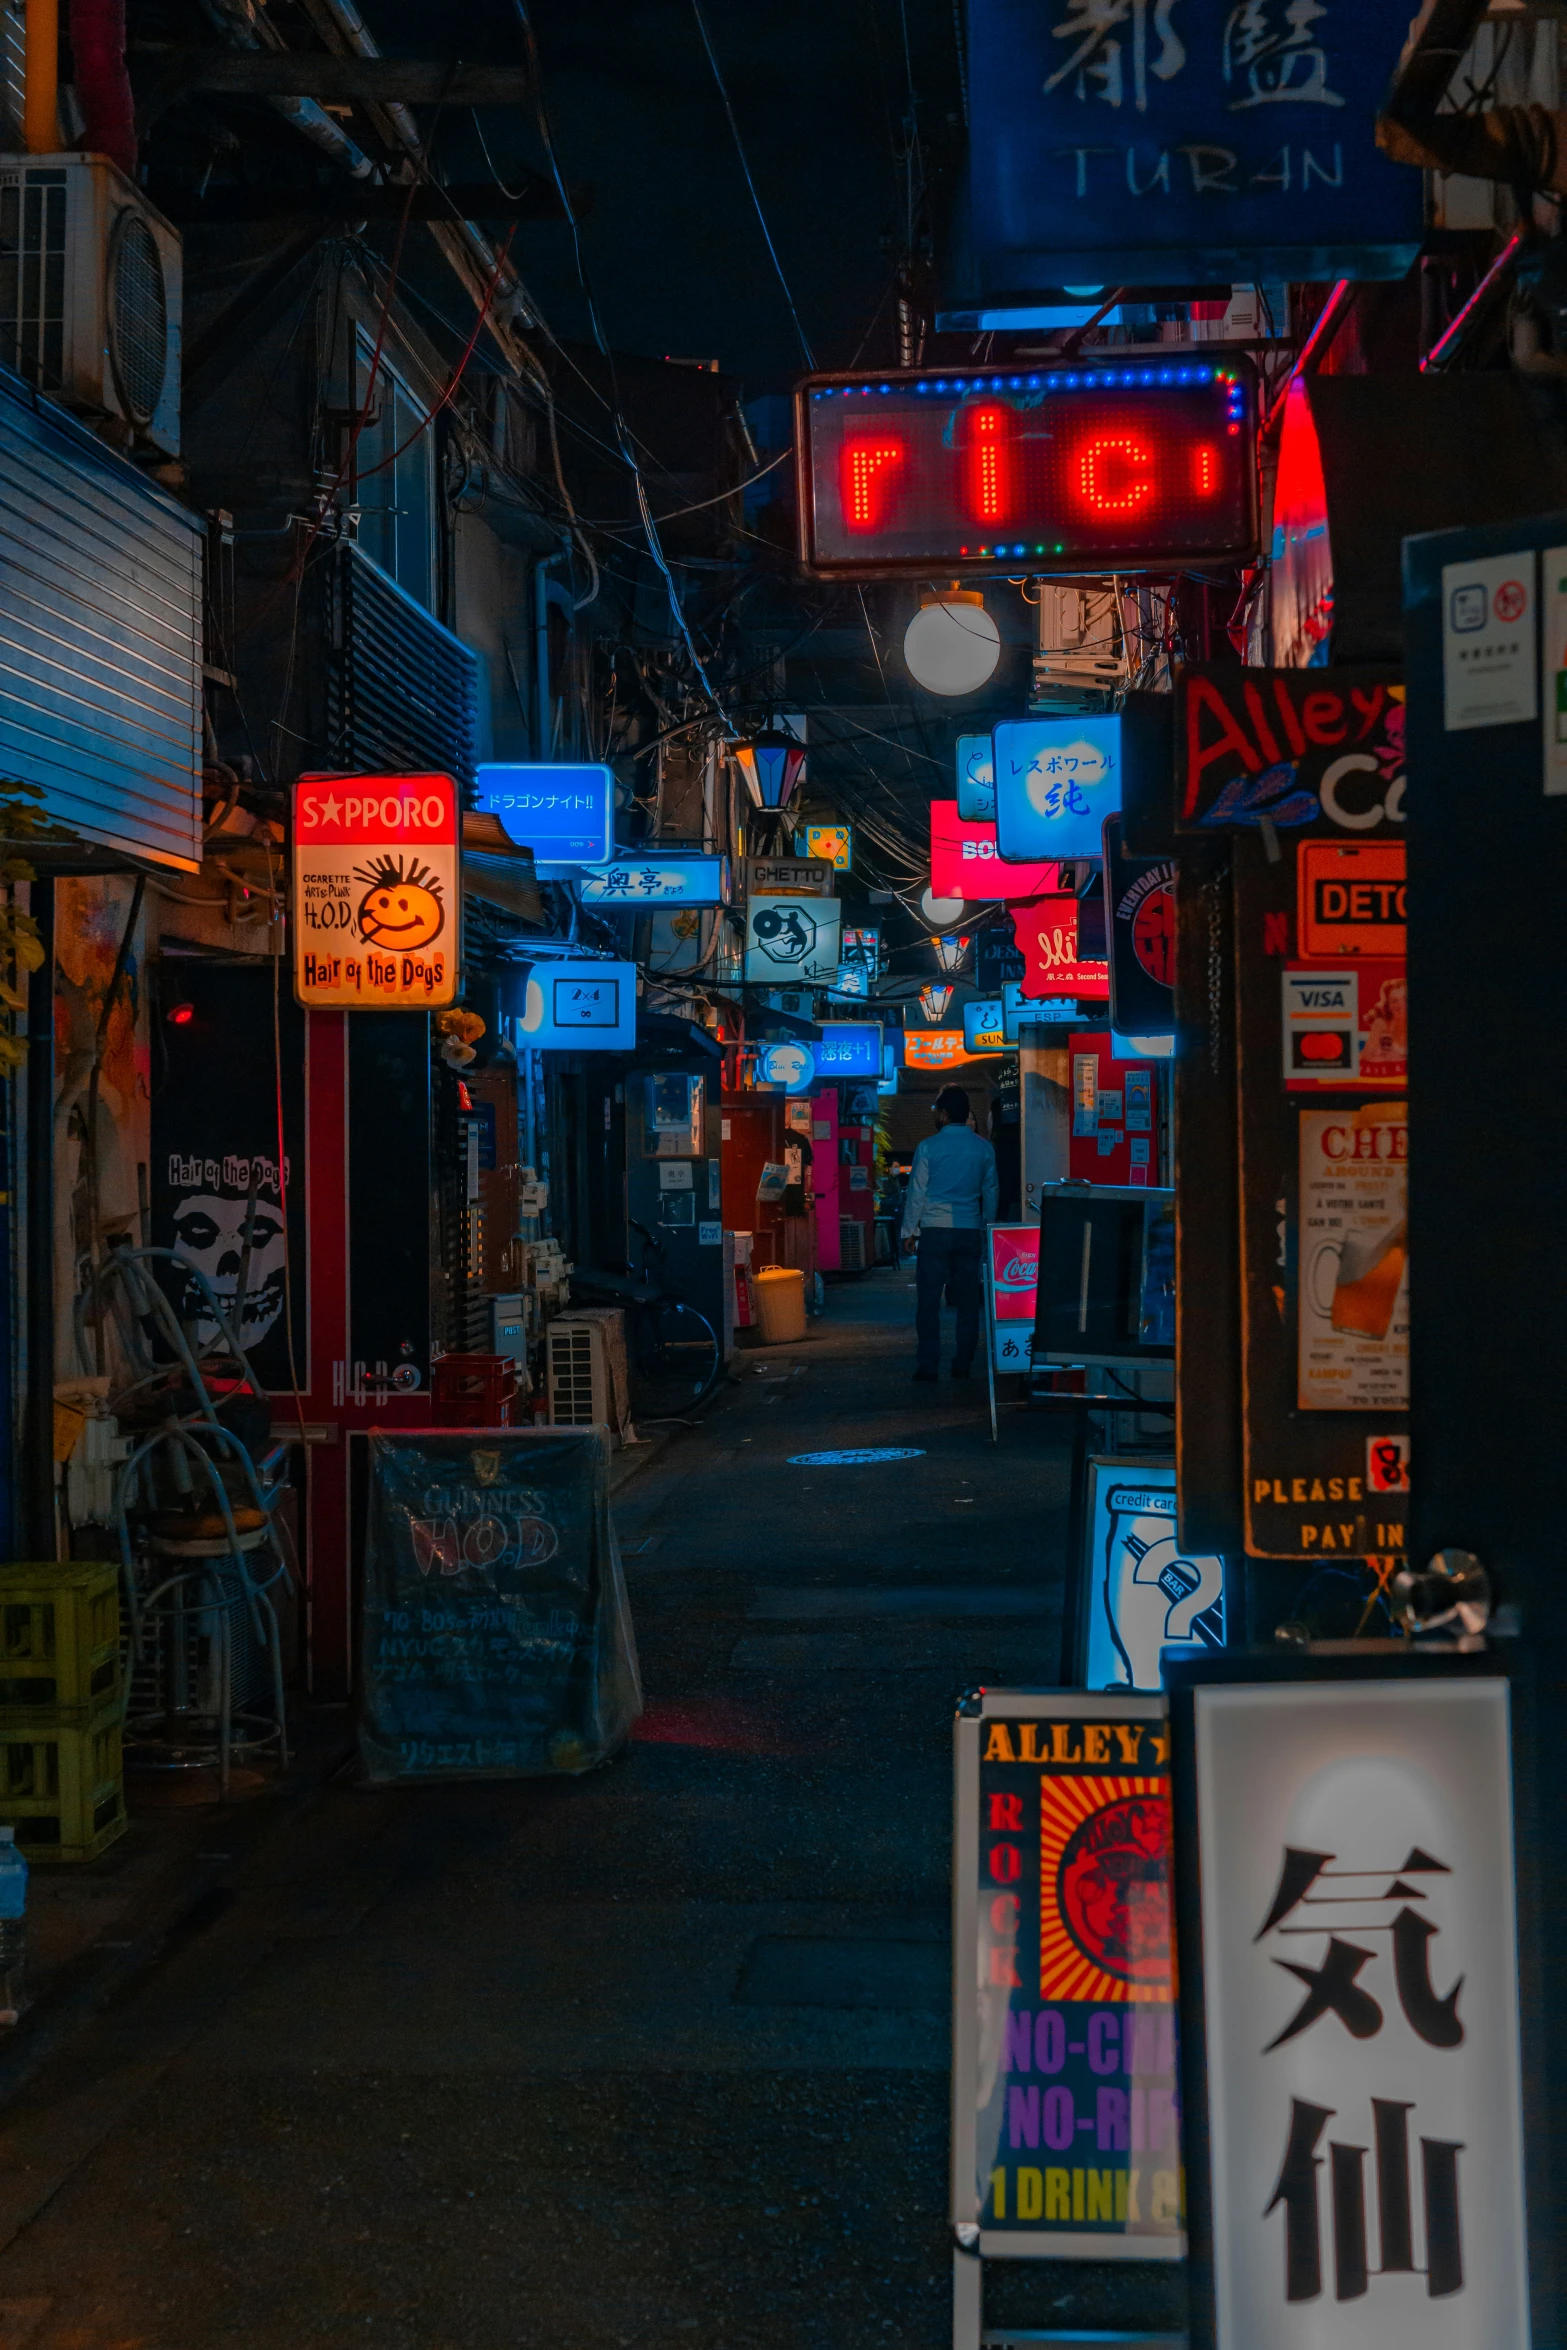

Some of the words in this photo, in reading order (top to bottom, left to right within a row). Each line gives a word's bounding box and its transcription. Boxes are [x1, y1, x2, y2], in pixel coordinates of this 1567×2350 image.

[1181, 674, 1386, 820] Alley
[1010, 754, 1118, 777] レスポワール
[1044, 778, 1092, 819] 純
[303, 874, 351, 884] CIGARETTE
[754, 866, 826, 884] GHETTO
[1115, 866, 1162, 921] EVERYDAY
[305, 955, 341, 987] Hair
[346, 961, 362, 990] of
[367, 955, 396, 986] the
[402, 959, 443, 991] Dogs
[1300, 991, 1345, 1008] VISA
[1034, 1012, 1062, 1023] ESP
[820, 1040, 872, 1061] 深夜+1
[169, 1157, 202, 1184] Hair
[224, 1158, 249, 1183] the
[504, 1325, 521, 1337] POST
[424, 1489, 546, 1516] GUINNESS
[1115, 1491, 1152, 1509] credit
[1253, 1475, 1364, 1505] PLEASE
[1301, 1522, 1355, 1550] PAY
[1375, 1522, 1405, 1549] IN
[1162, 1572, 1186, 1596] BAR
[983, 1722, 1146, 1765] ALLEY
[1252, 1845, 1467, 2305] 気仙
[1015, 2165, 1142, 2223] DRINK
